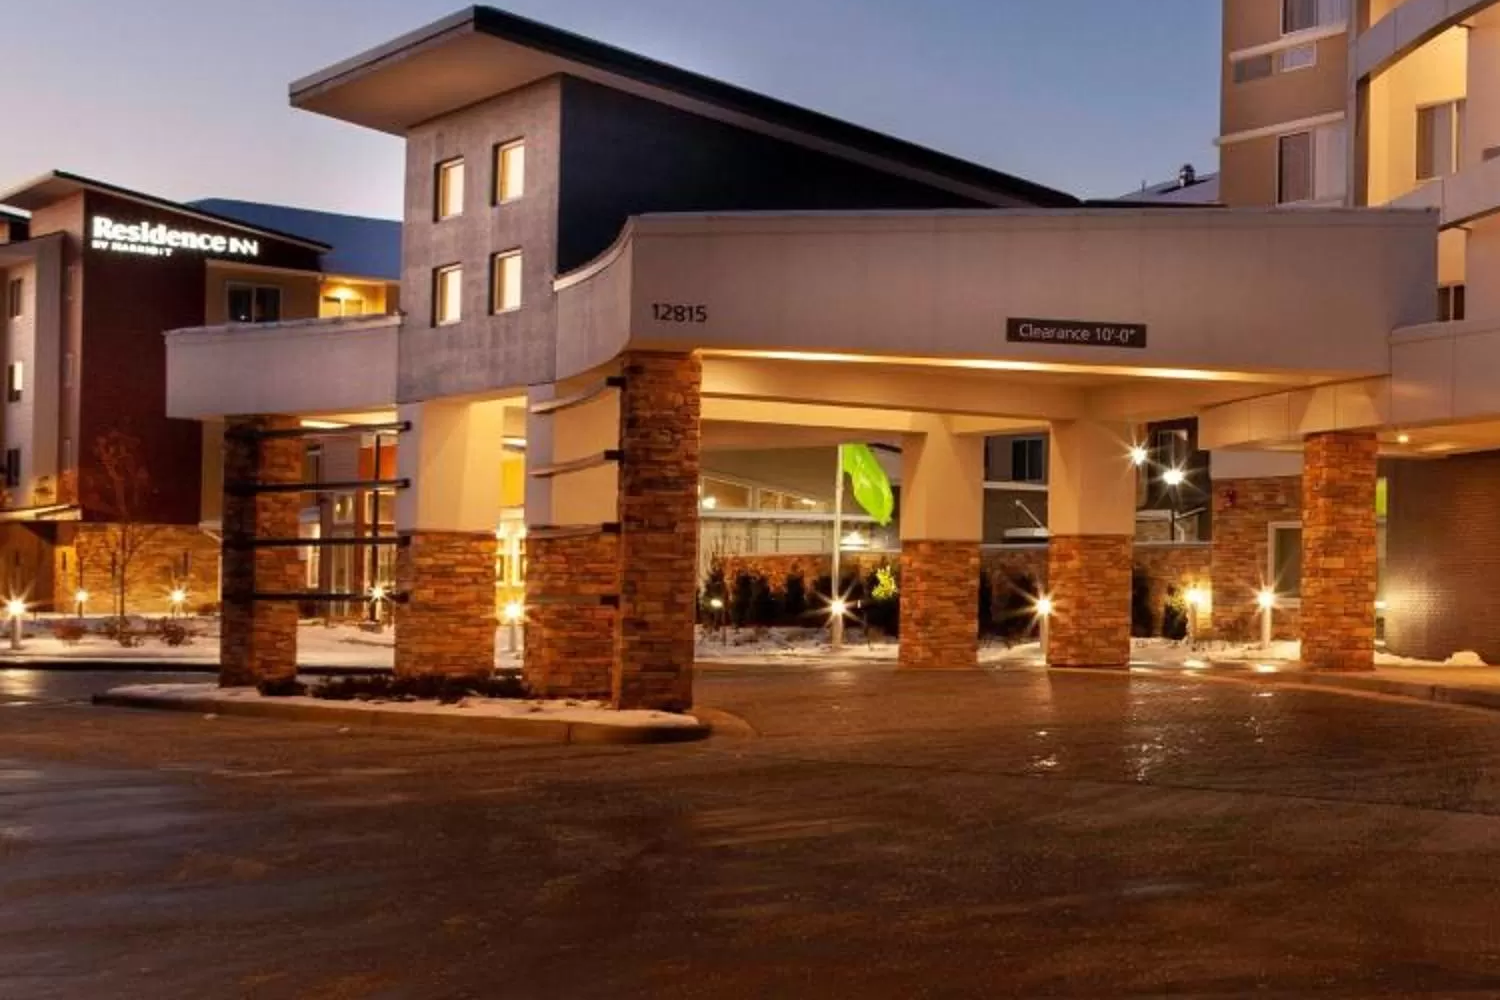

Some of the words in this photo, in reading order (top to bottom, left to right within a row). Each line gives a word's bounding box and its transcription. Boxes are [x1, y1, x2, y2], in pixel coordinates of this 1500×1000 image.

[92, 215, 226, 253] Residence
[651, 303, 708, 323] 12815
[1019, 323, 1091, 341] Clearance
